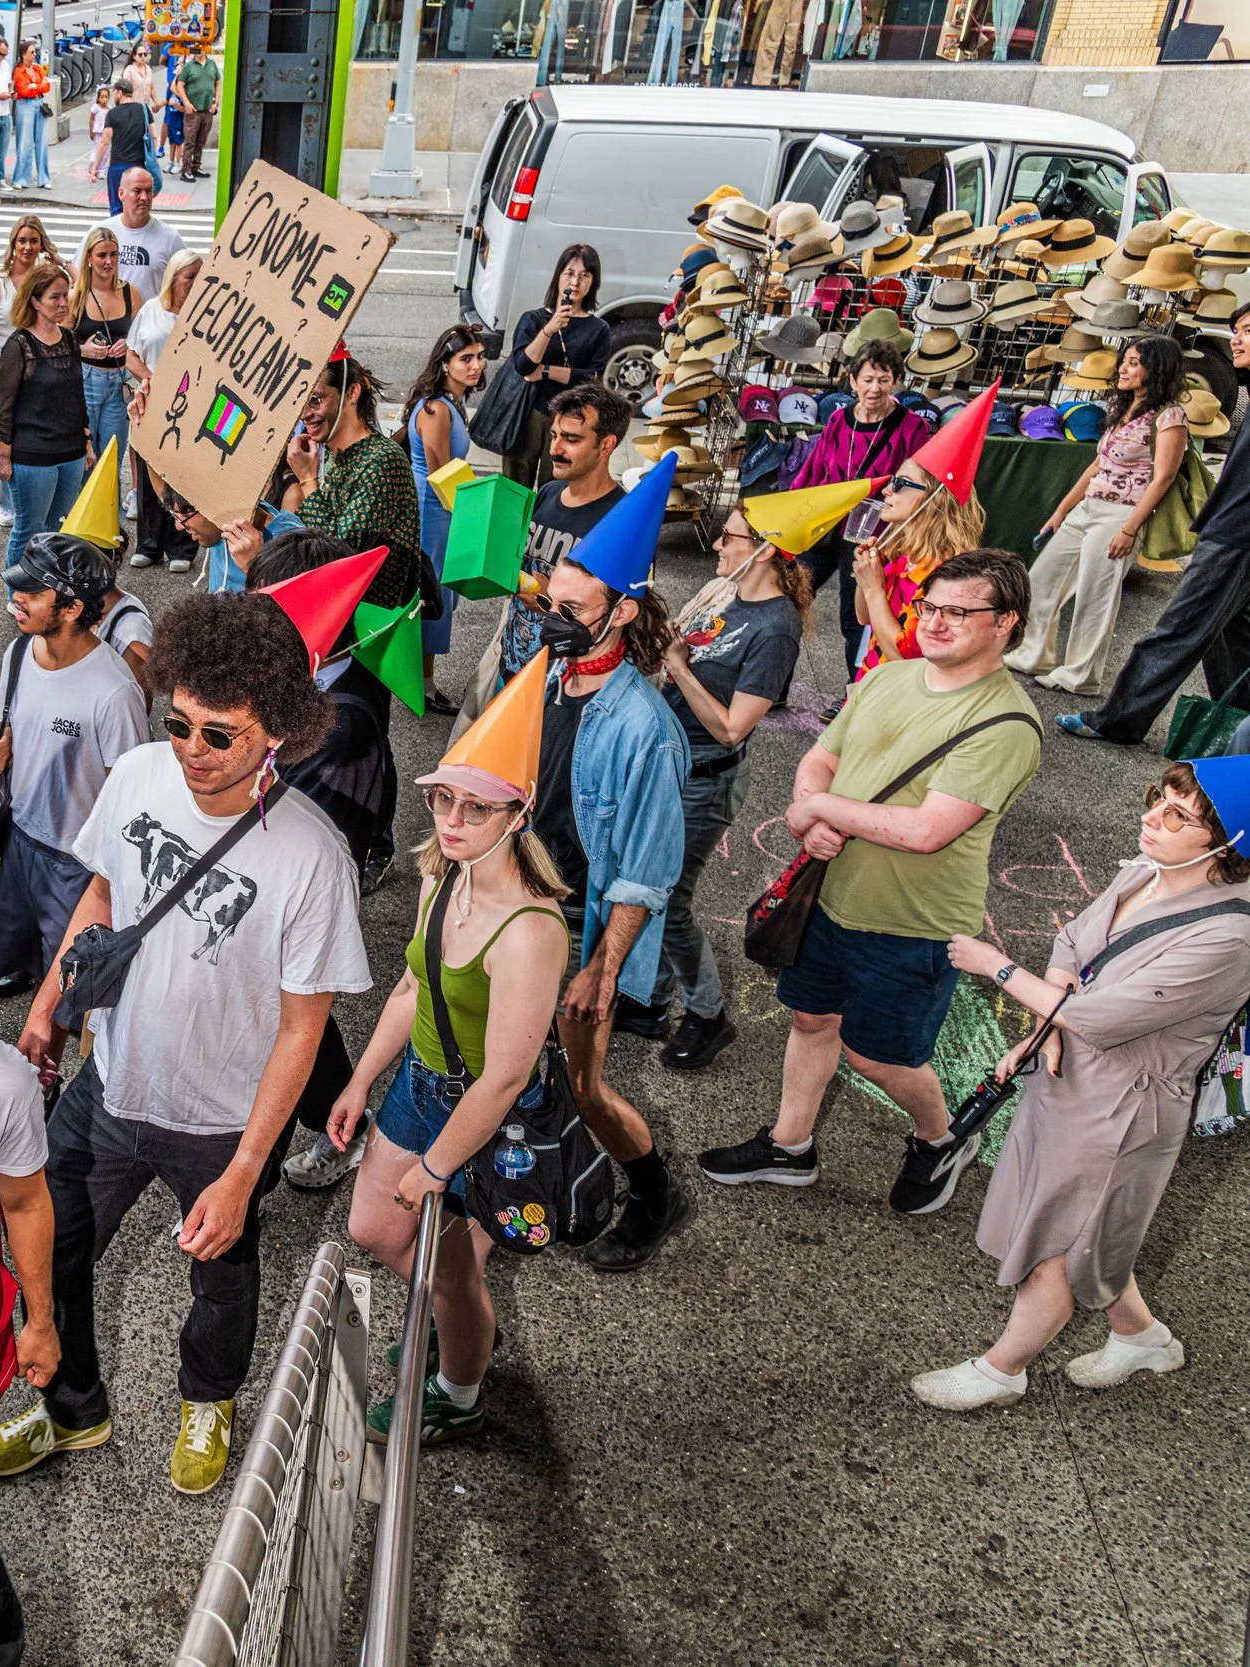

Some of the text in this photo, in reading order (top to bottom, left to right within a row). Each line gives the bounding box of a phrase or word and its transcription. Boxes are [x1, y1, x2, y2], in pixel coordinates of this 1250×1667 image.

[119, 251, 136, 259] RTH
[230, 190, 337, 309] GNOME
[754, 400, 770, 413] NY
[794, 400, 809, 413] NY
[52, 717, 80, 731] JACK&
[51, 725, 80, 738] JONES
